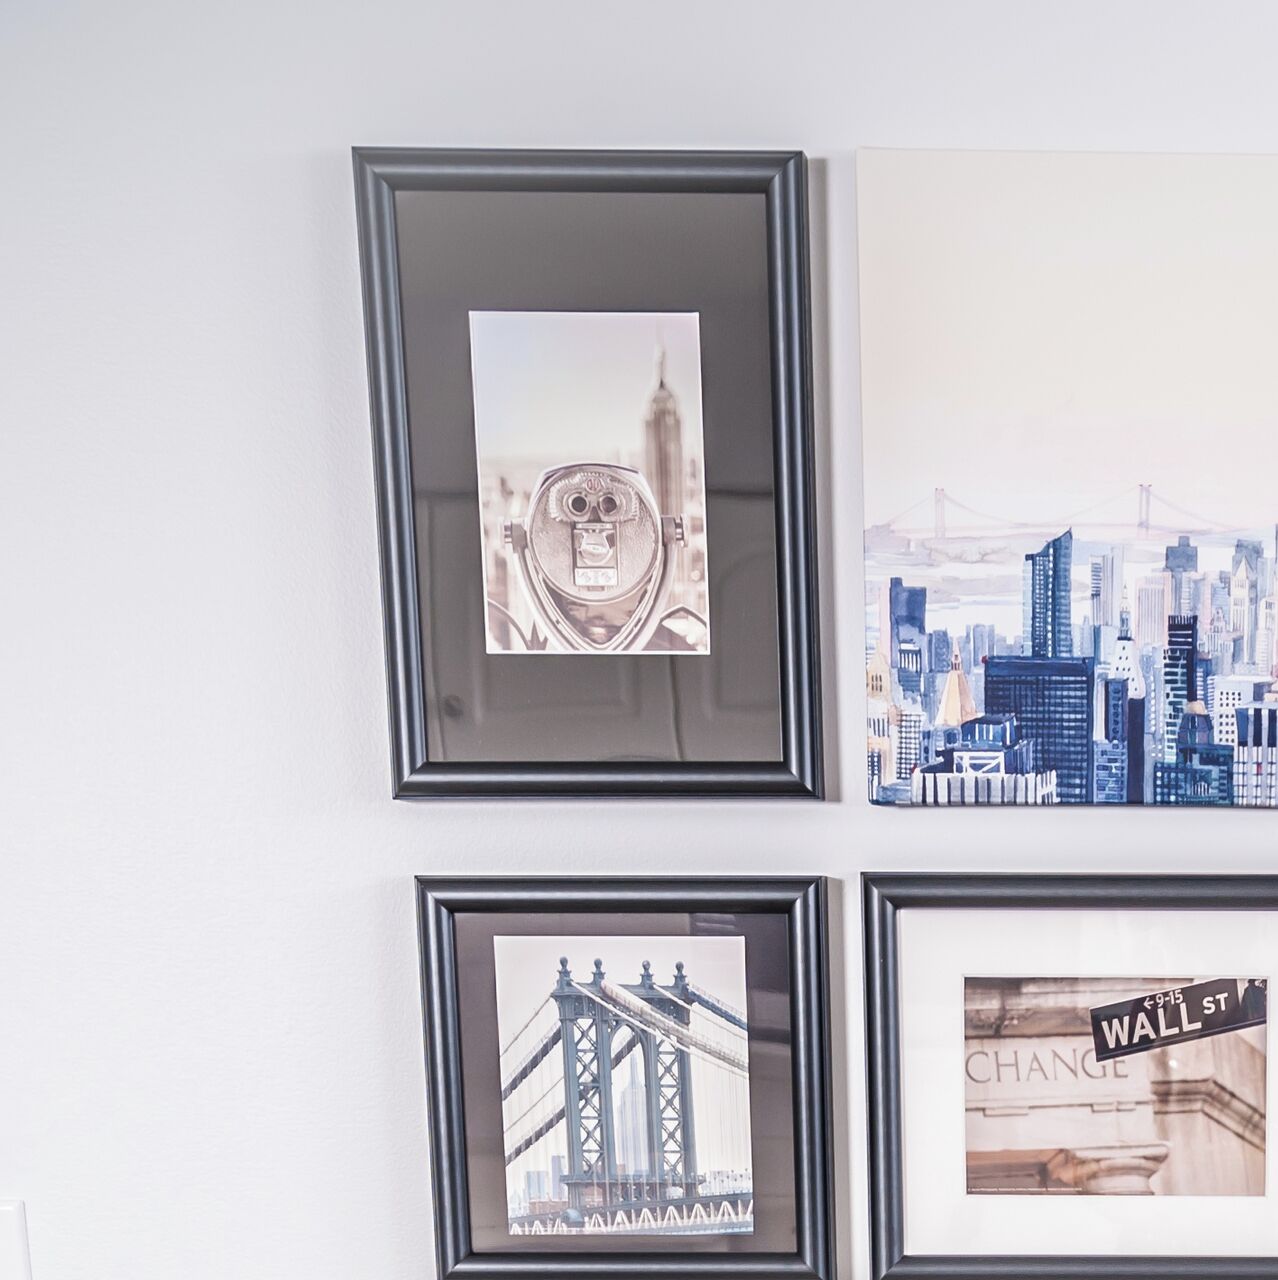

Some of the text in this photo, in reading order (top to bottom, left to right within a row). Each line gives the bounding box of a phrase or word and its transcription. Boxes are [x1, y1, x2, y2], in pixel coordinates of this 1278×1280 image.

[1155, 988, 1184, 1009] 9-15
[1101, 991, 1229, 1049] WALL ST
[965, 1047, 1130, 1084] CHANGE
